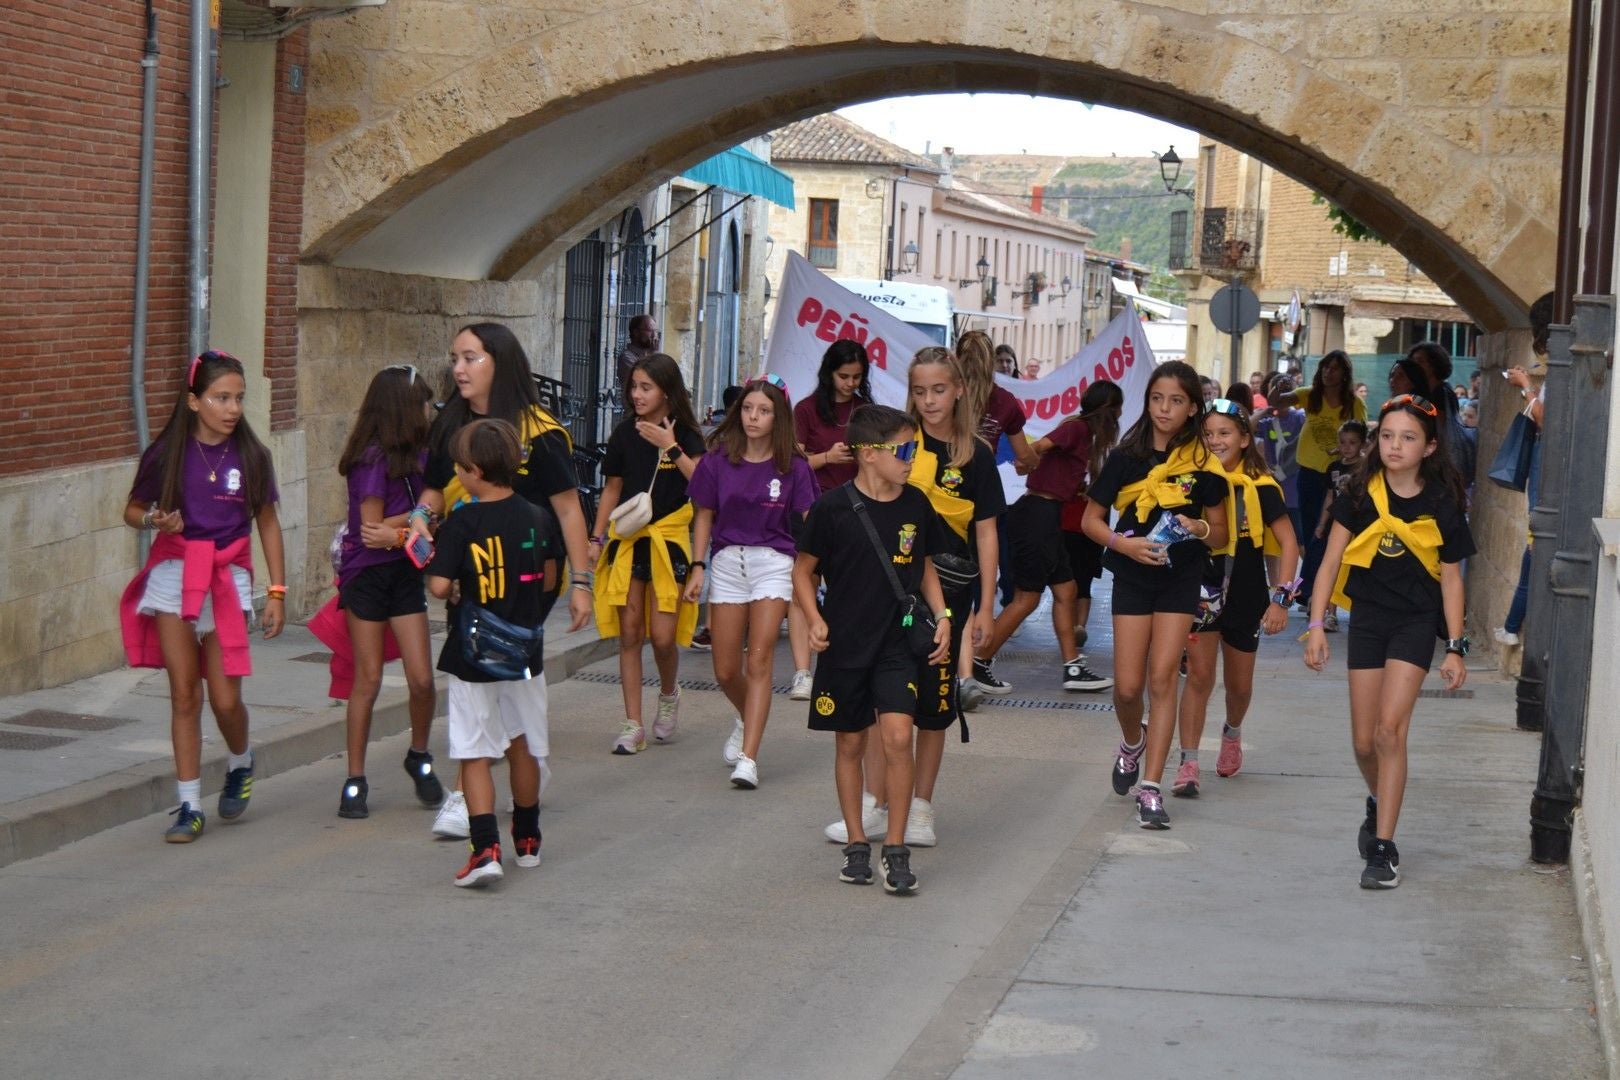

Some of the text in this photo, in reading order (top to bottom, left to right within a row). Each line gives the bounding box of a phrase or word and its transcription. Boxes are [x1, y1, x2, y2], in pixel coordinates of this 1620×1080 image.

[797, 296, 887, 371] PEÑA
[470, 536, 504, 573] NI
[479, 567, 505, 604] NI
[817, 698, 833, 710] BVB
